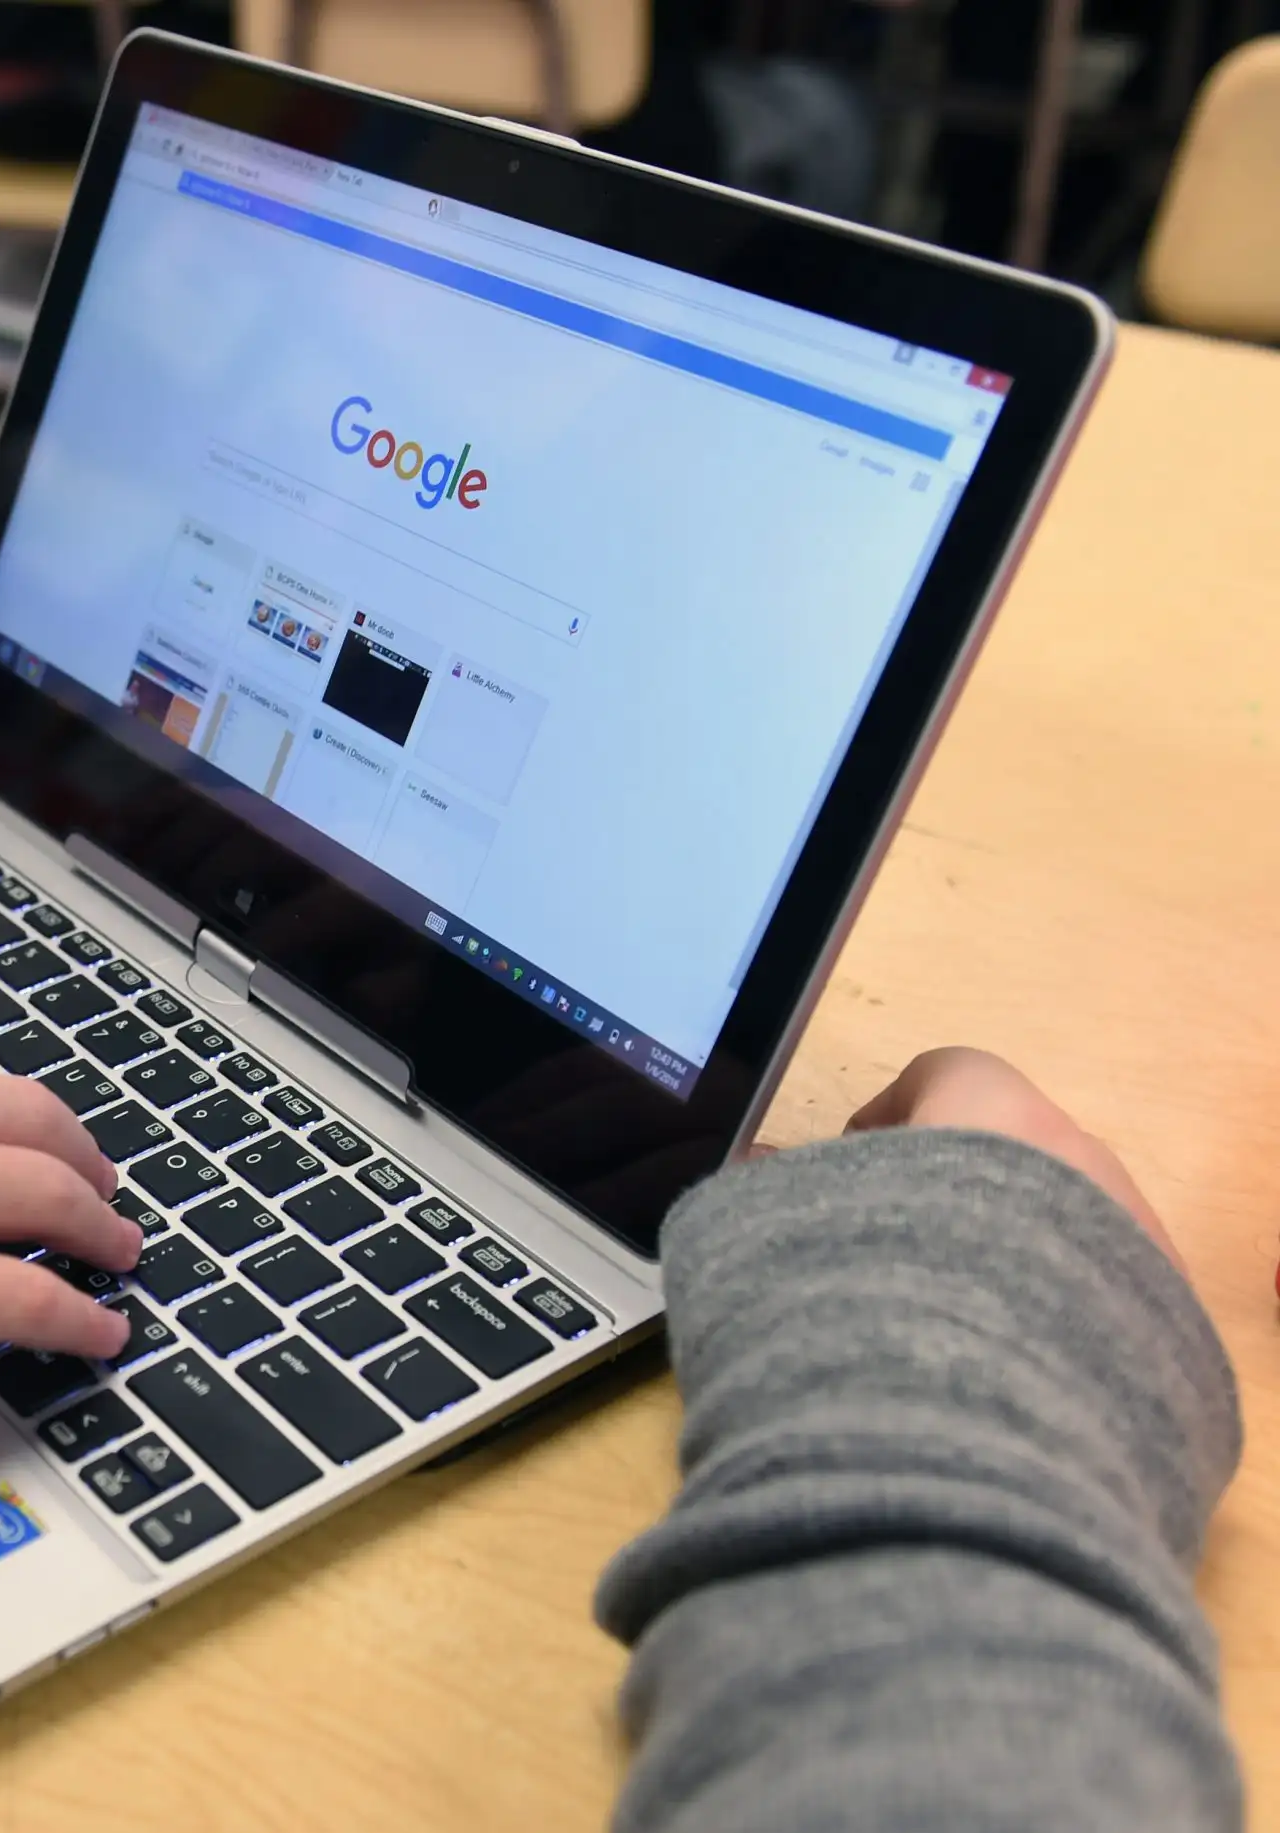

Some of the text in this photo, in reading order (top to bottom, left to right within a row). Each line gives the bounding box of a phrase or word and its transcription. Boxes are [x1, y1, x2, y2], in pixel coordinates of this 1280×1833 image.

[331, 396, 488, 510] Google
[377, 624, 395, 640] doob
[466, 670, 516, 704] Little Alchemy
[325, 734, 347, 753] Create
[350, 748, 382, 775] Discovery
[420, 788, 449, 812] Seesaw
[0, 955, 18, 968] 5
[45, 991, 62, 1003] 6
[20, 1029, 38, 1042] Y
[91, 1028, 109, 1039] 7
[231, 1055, 250, 1071] f10
[671, 1058, 687, 1076] PM
[65, 1069, 86, 1083] U
[140, 1068, 157, 1080] 8
[192, 1109, 208, 1120] 9
[324, 1125, 343, 1141] f12
[166, 1154, 187, 1169] O
[245, 1153, 262, 1165] 0
[383, 1163, 405, 1184] home
[219, 1198, 238, 1209] P
[436, 1207, 456, 1222] end
[486, 1243, 512, 1265] insert
[449, 1282, 507, 1331] backspace
[545, 1289, 574, 1312] delete
[279, 1350, 311, 1376] enter
[183, 1373, 211, 1397] shift
